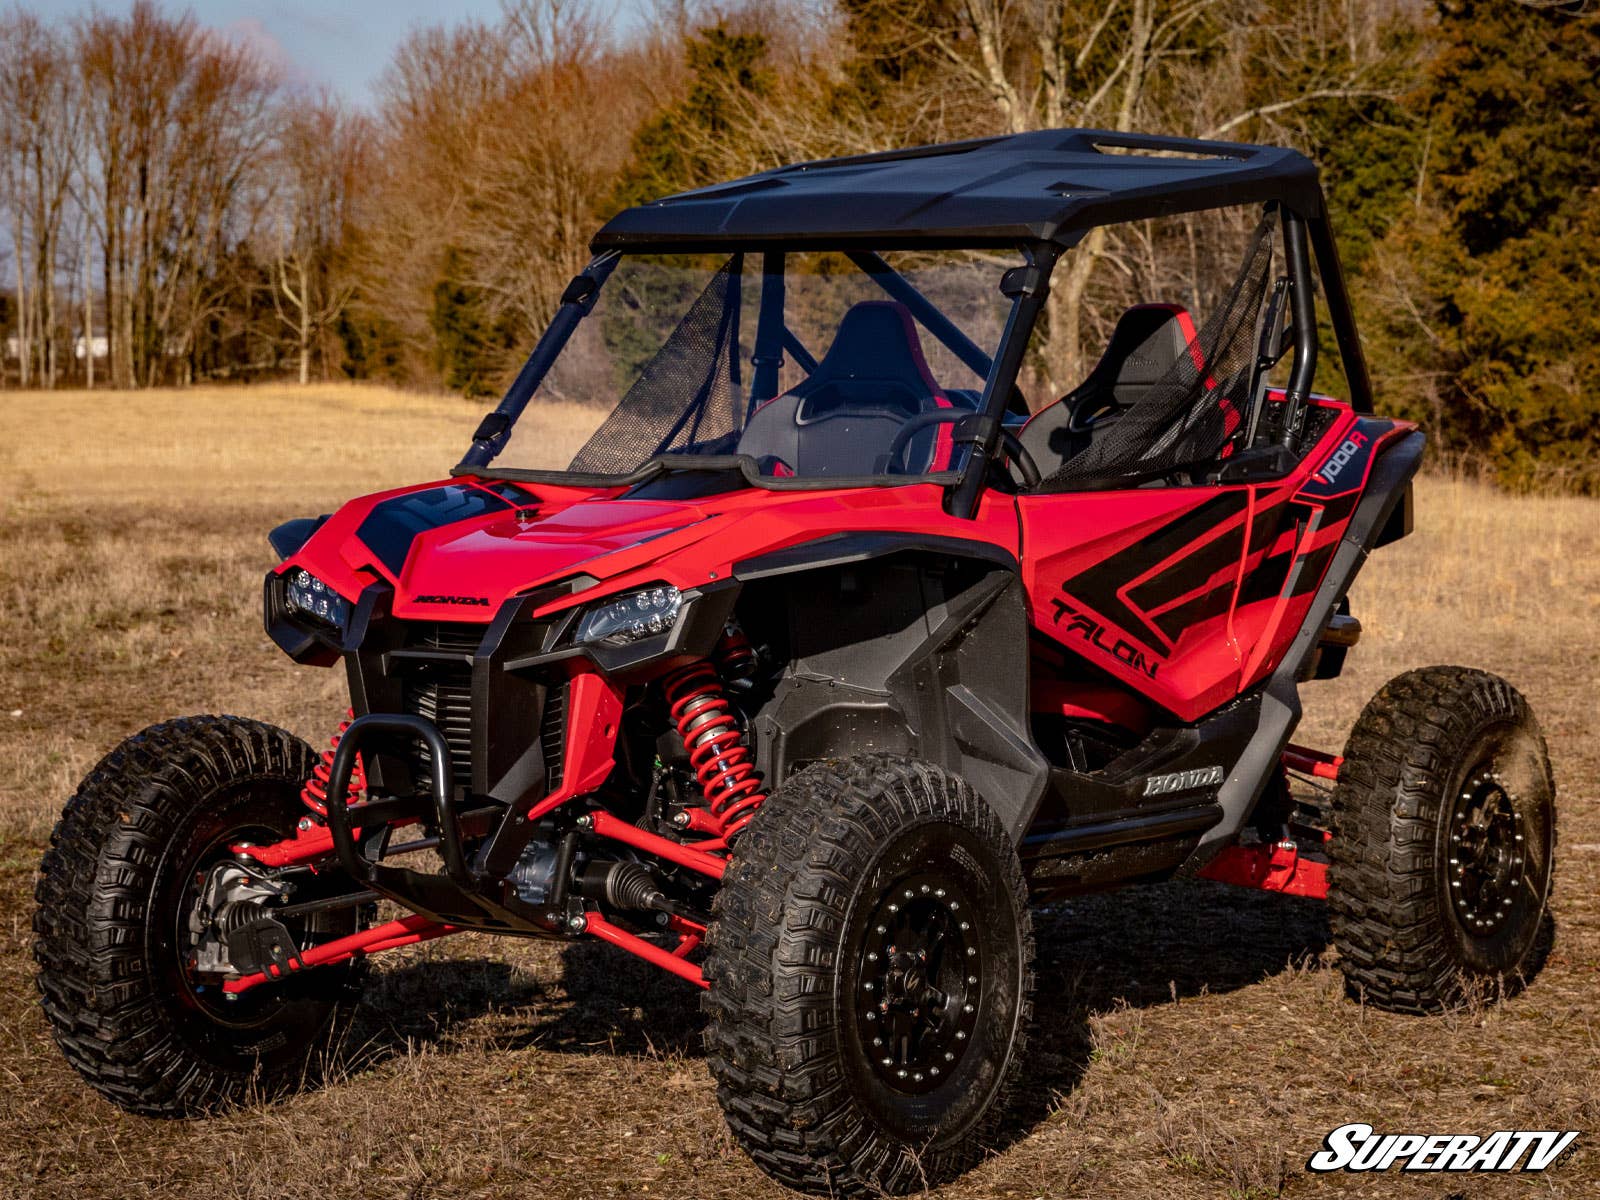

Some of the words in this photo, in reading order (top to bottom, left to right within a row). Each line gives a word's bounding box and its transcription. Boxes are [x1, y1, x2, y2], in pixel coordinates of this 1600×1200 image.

[1320, 430, 1369, 484] 1000R
[412, 595, 490, 607] HONDA
[1050, 598, 1159, 680] TALON
[1142, 765, 1224, 797] HONDA
